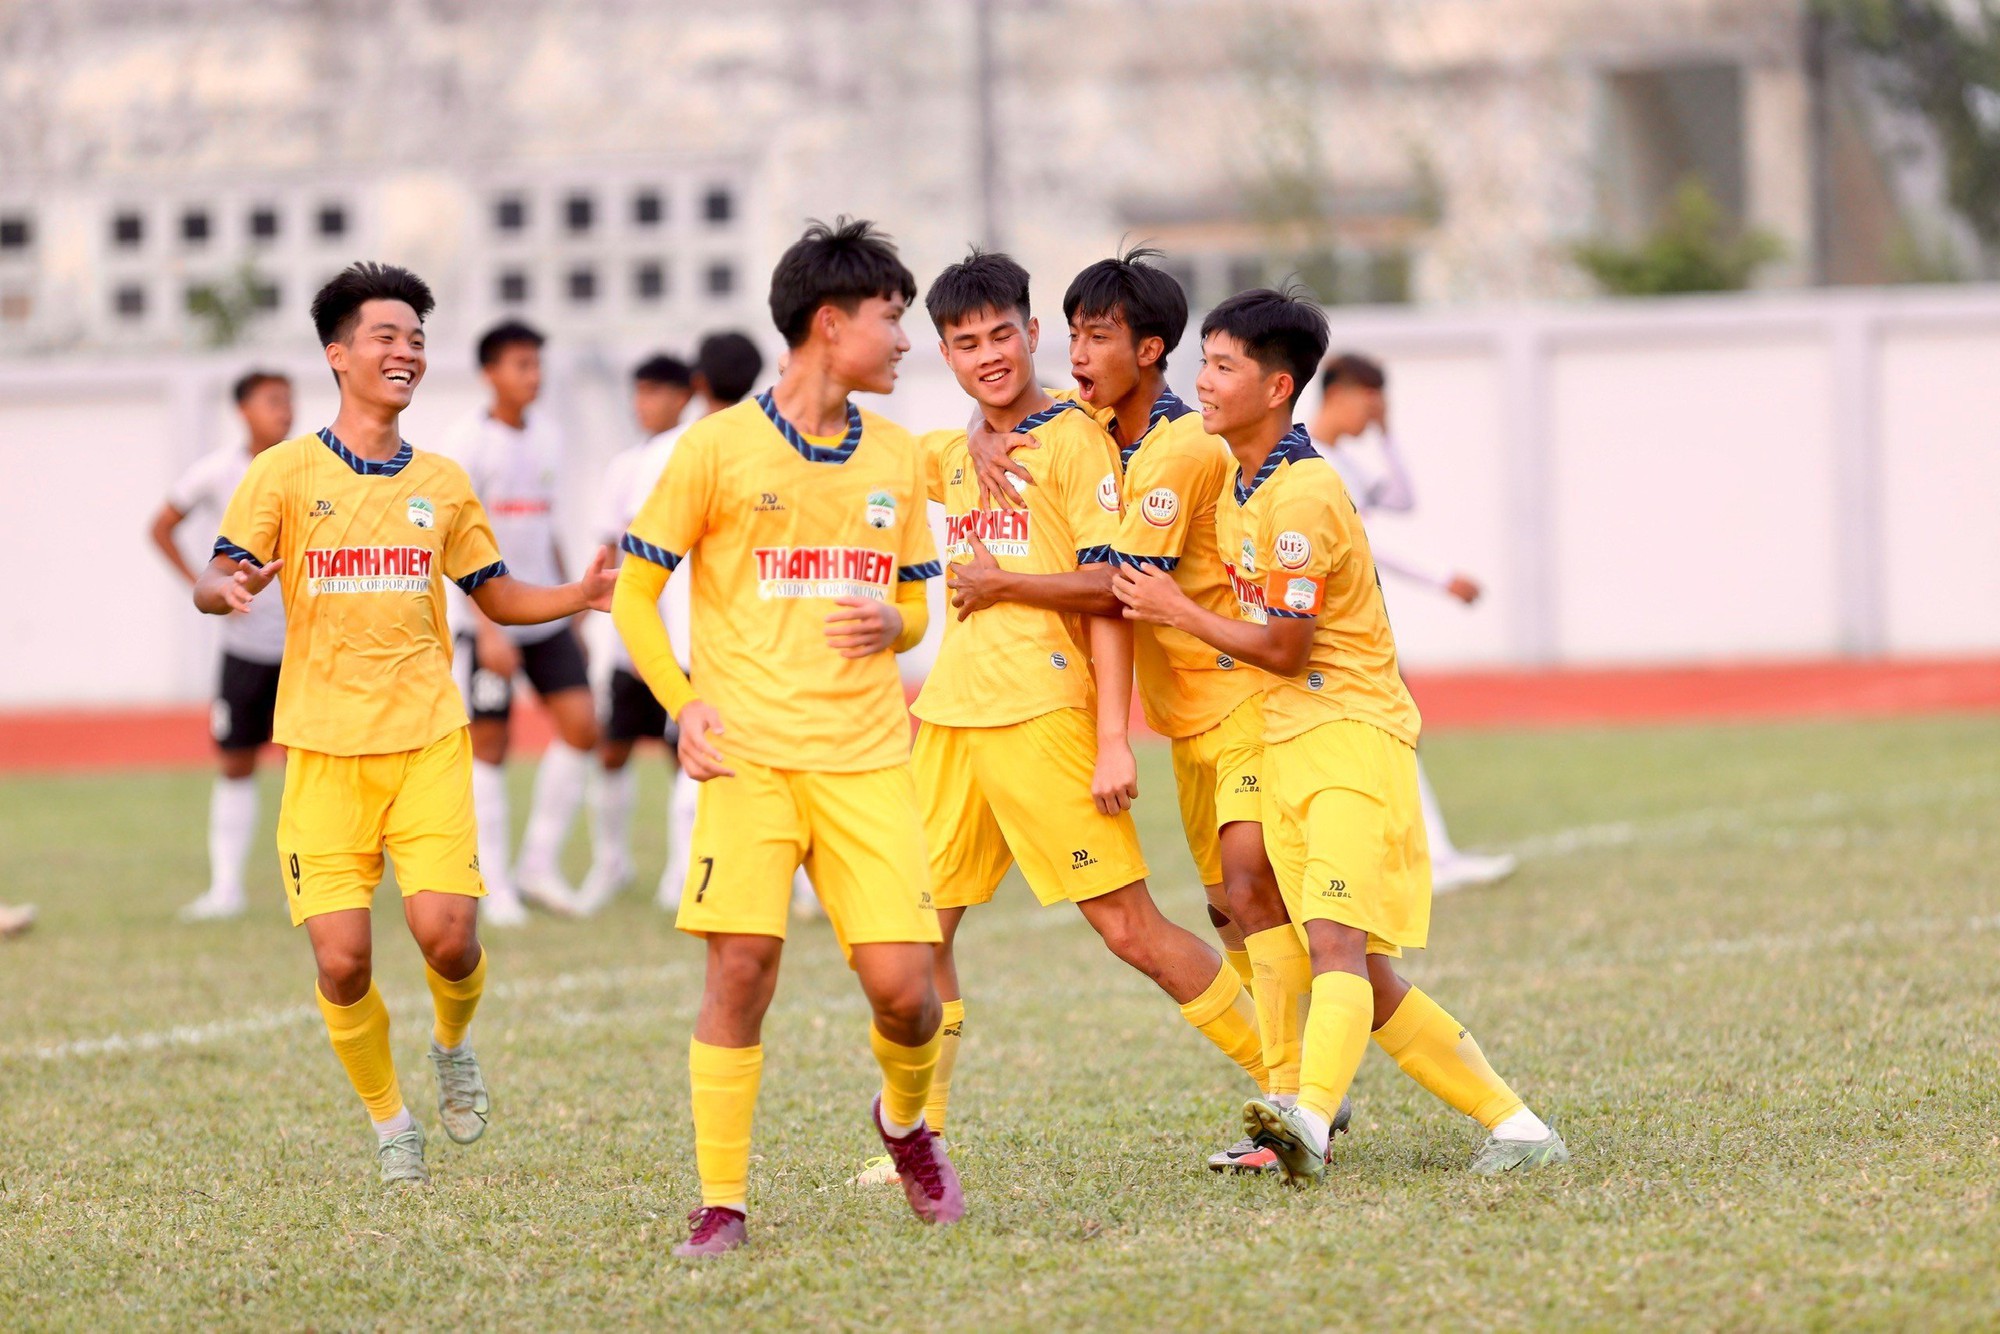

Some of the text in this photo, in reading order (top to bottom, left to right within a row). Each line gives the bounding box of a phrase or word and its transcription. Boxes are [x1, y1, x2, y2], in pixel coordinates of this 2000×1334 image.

[305, 549, 380, 578] THANH
[755, 549, 838, 580] THANH
[321, 579, 428, 592] MEDIA CORPORATIO
[776, 583, 813, 596] MEDIA
[695, 856, 714, 903] 7
